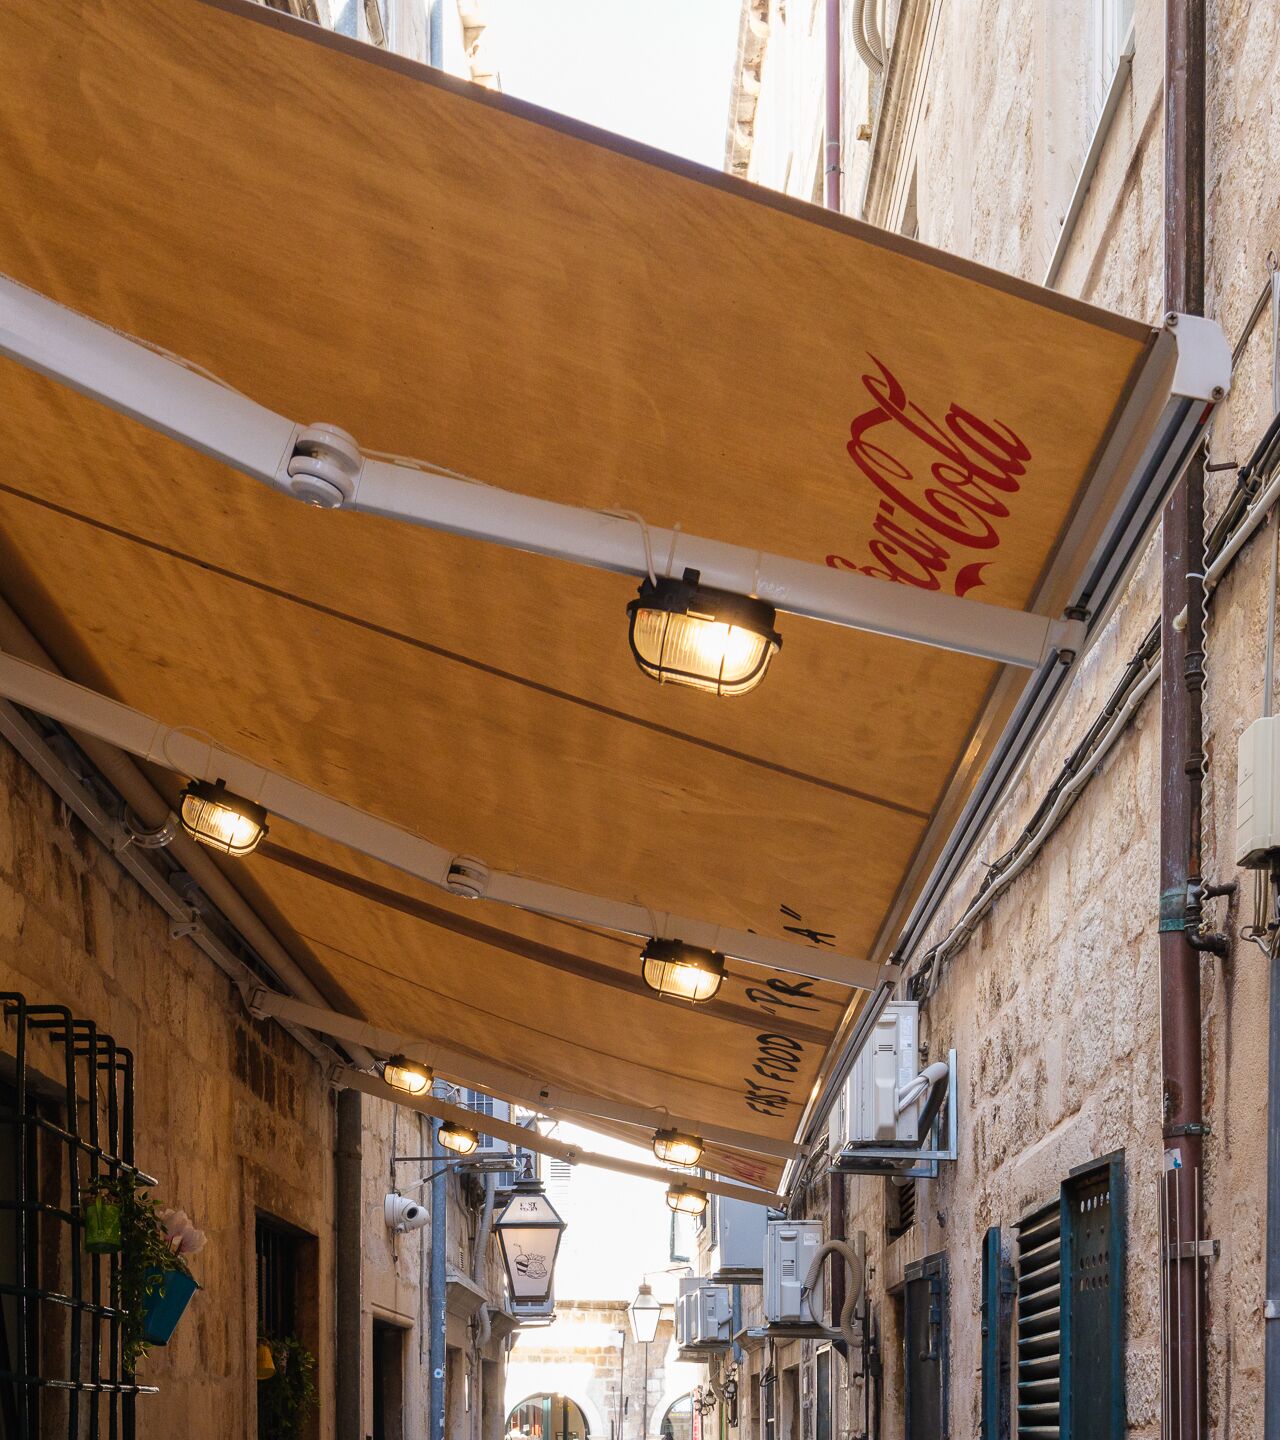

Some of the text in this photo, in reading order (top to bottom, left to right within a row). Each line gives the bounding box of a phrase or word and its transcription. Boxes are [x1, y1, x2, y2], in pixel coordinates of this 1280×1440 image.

[825, 351, 1032, 597] ca-Cola
[752, 1033, 804, 1083] FOOD
[744, 1078, 790, 1117] FAST
